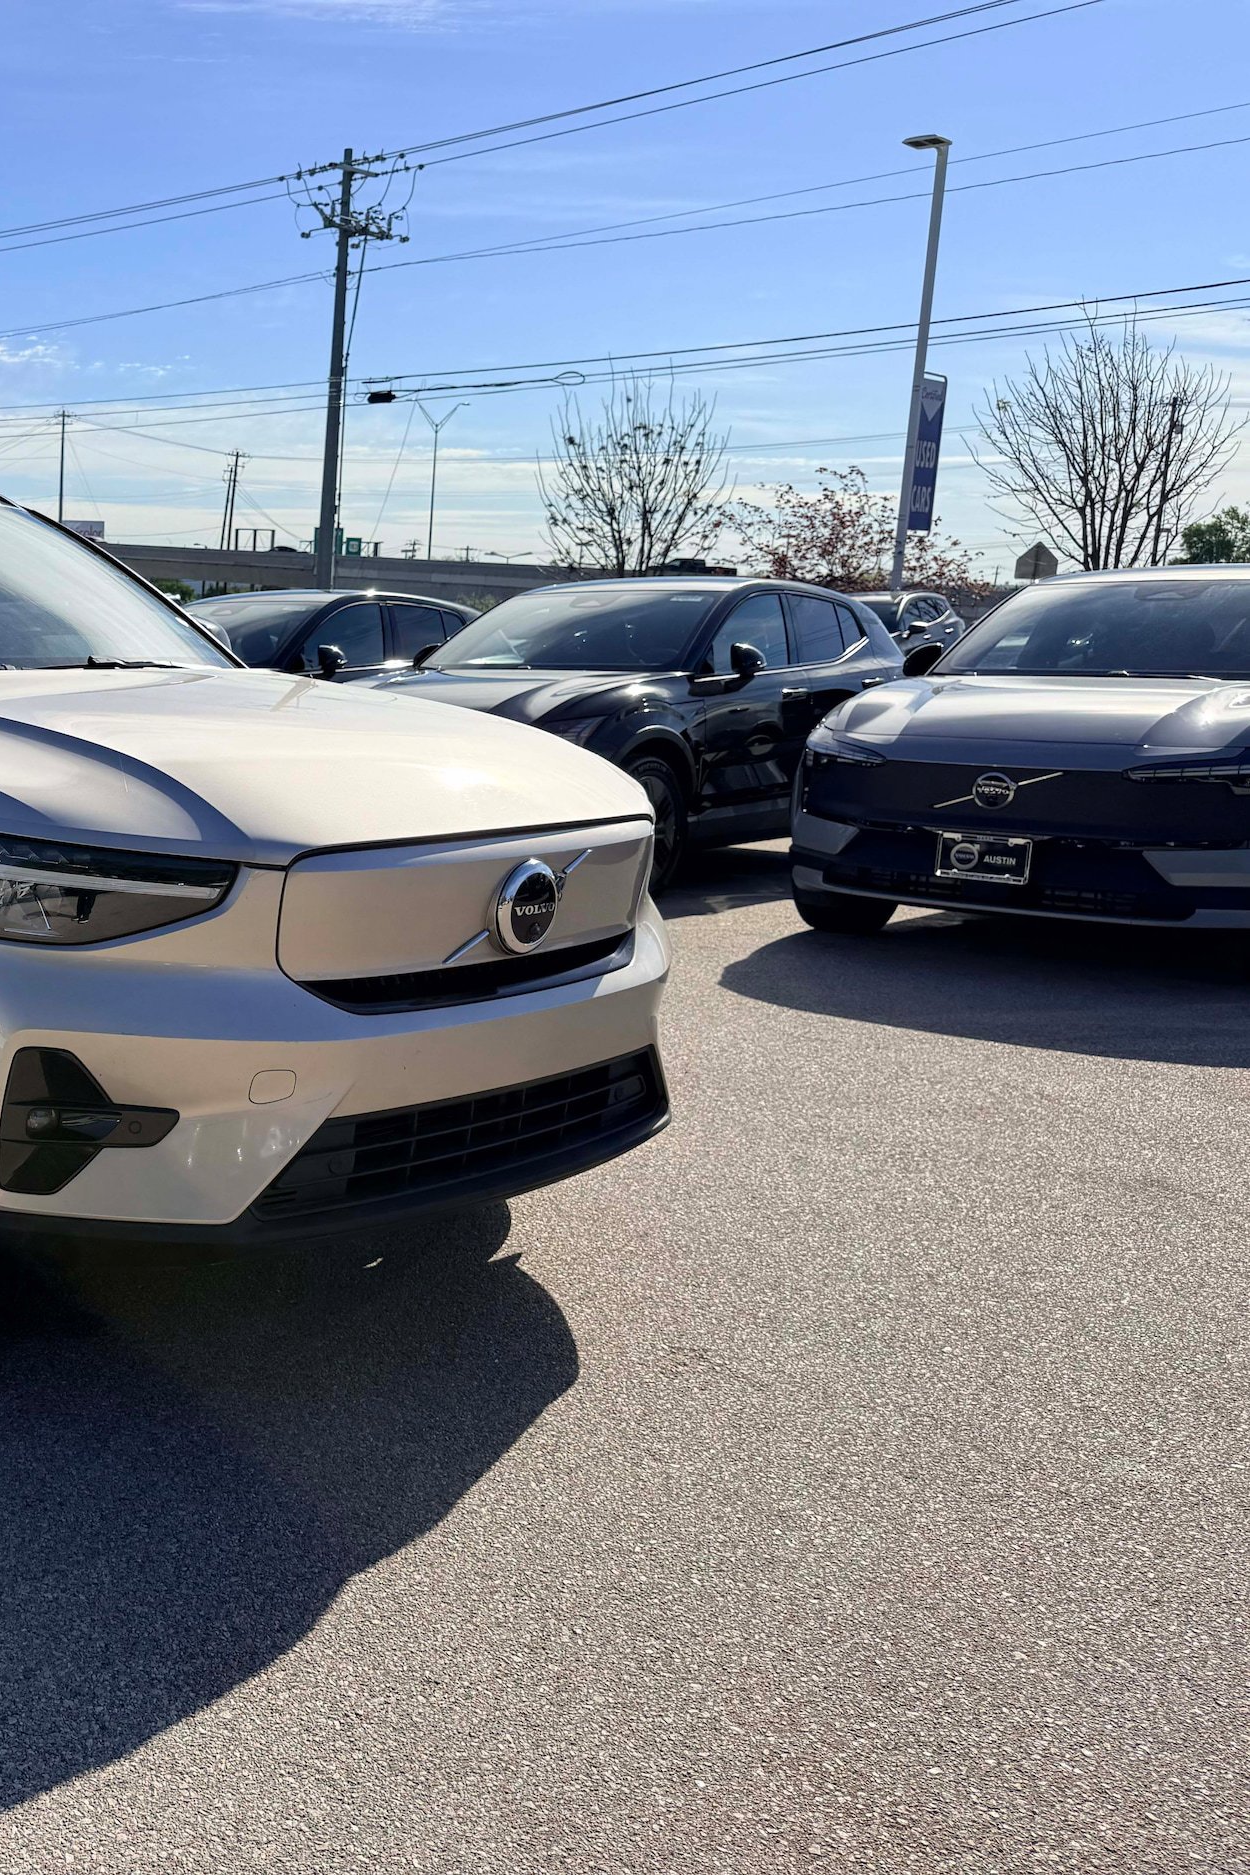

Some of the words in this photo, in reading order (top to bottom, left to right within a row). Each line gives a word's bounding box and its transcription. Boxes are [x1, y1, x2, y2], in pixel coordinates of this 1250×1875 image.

[915, 440, 936, 469] USED
[910, 486, 932, 513] CARS
[983, 855, 1016, 865] AUSTIN
[514, 902, 555, 916] VOLVO
